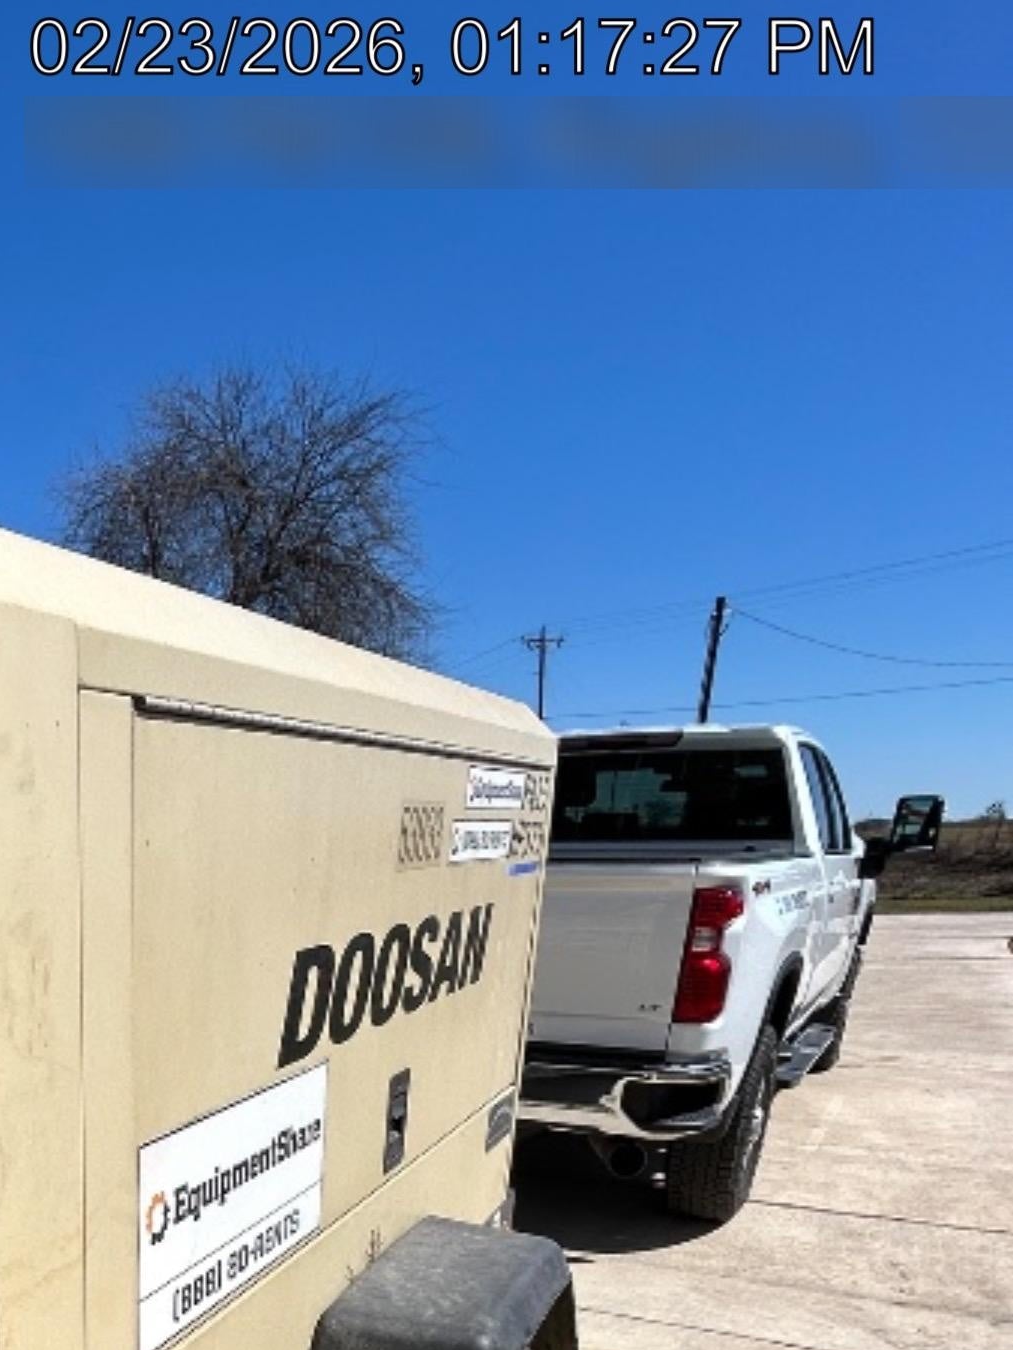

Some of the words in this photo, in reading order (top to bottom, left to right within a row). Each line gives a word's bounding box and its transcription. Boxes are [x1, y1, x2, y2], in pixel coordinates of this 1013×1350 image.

[276, 902, 494, 1070] DOOSAN
[173, 1118, 321, 1225] EquipmentShare
[172, 1259, 223, 1323] (888)
